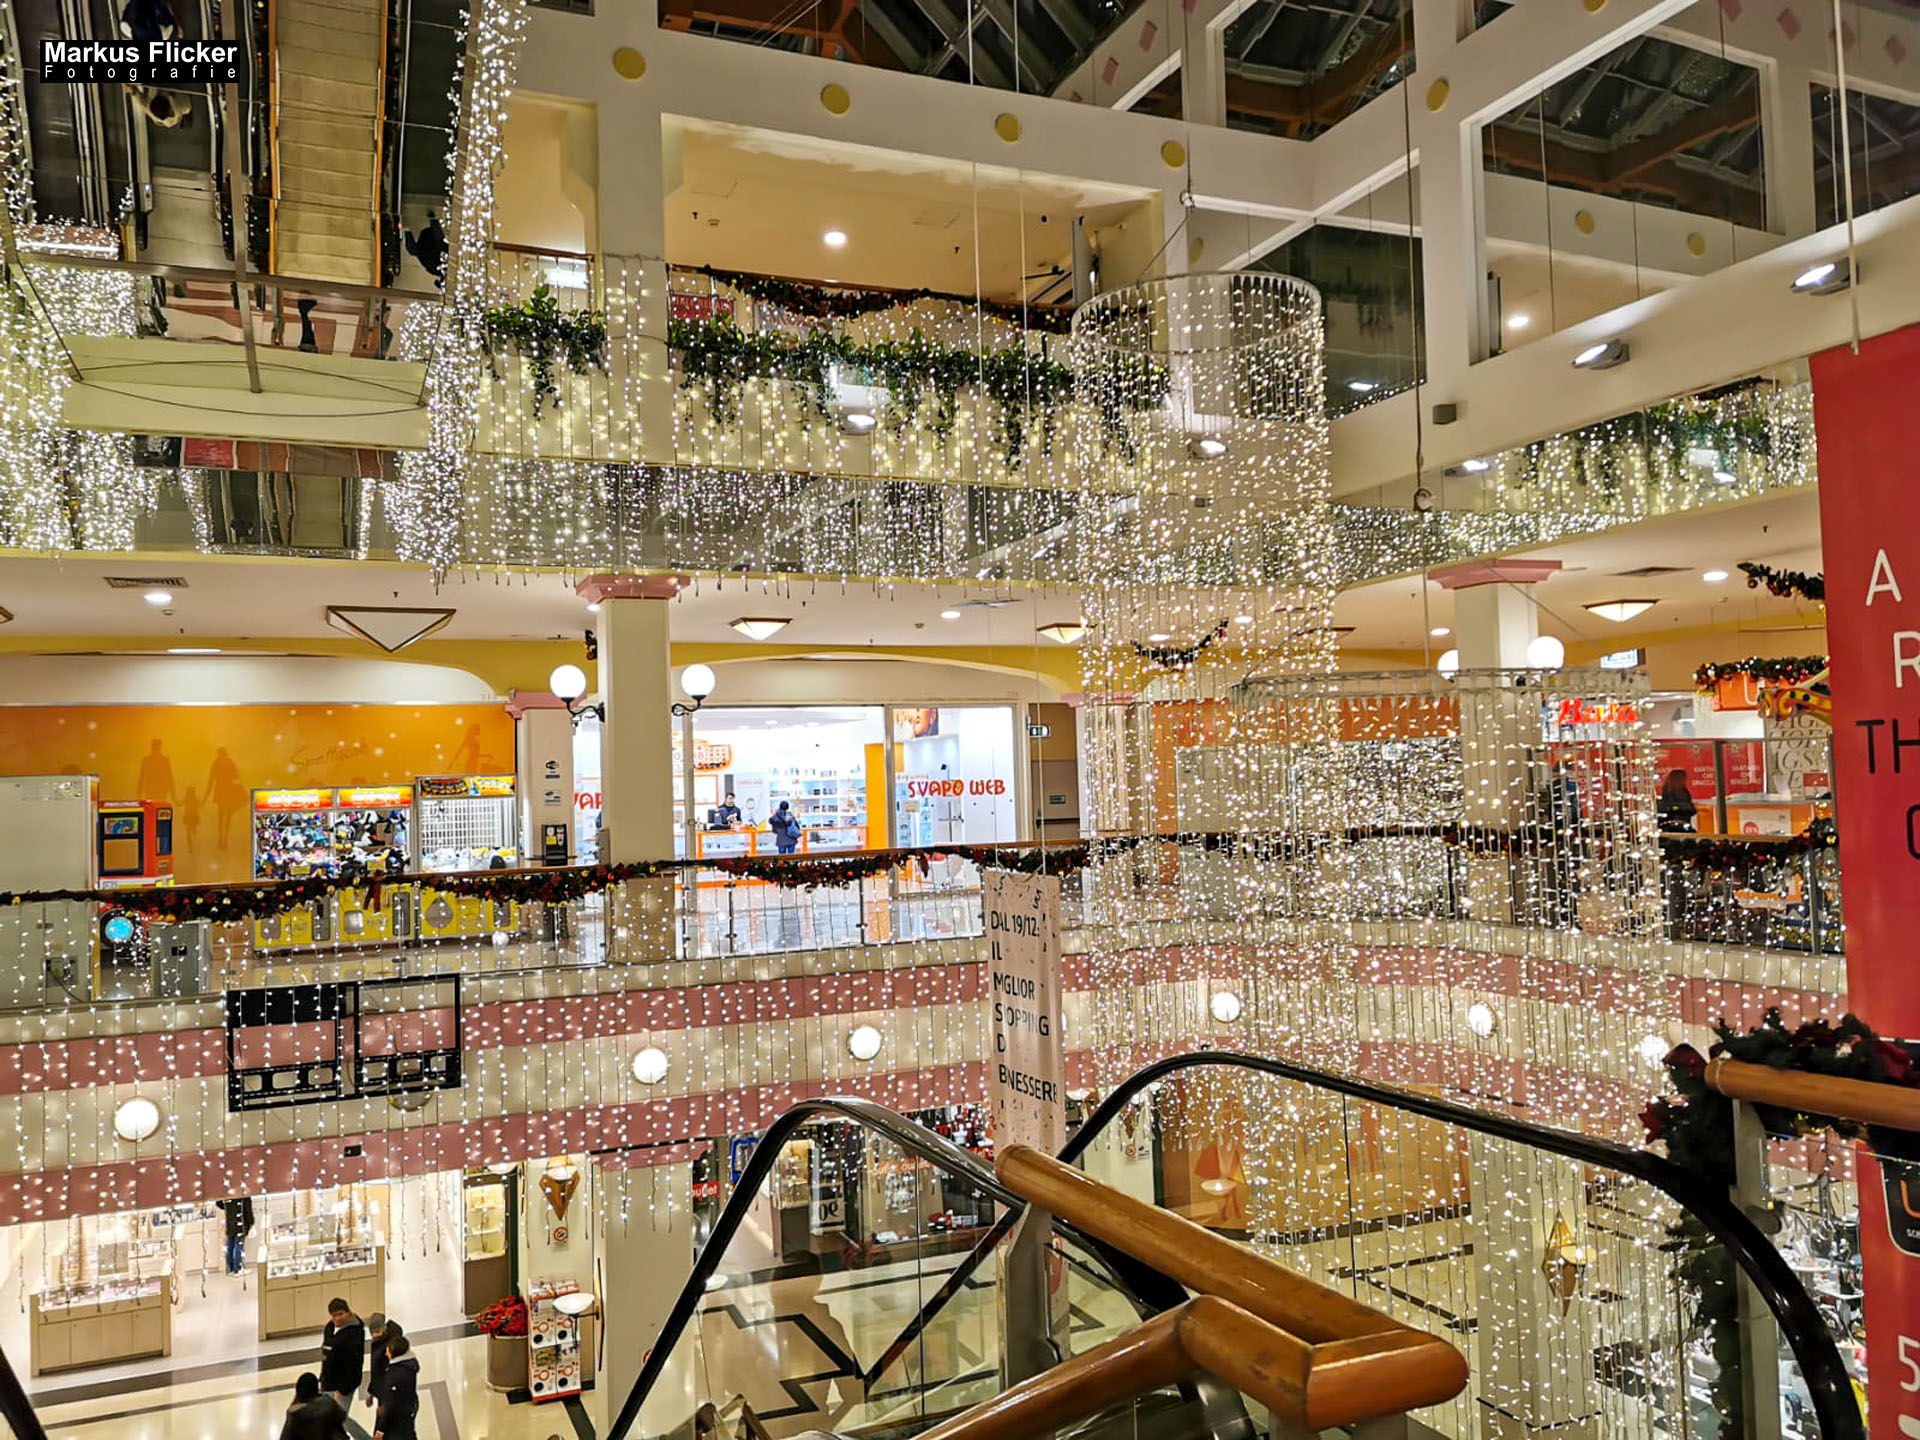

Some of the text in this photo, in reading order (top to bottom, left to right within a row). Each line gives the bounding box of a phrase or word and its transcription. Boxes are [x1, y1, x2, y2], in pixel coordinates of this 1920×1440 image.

[1865, 548, 1903, 606] A
[908, 778, 1006, 799] SVAPO WEB
[991, 940, 1003, 961] IL
